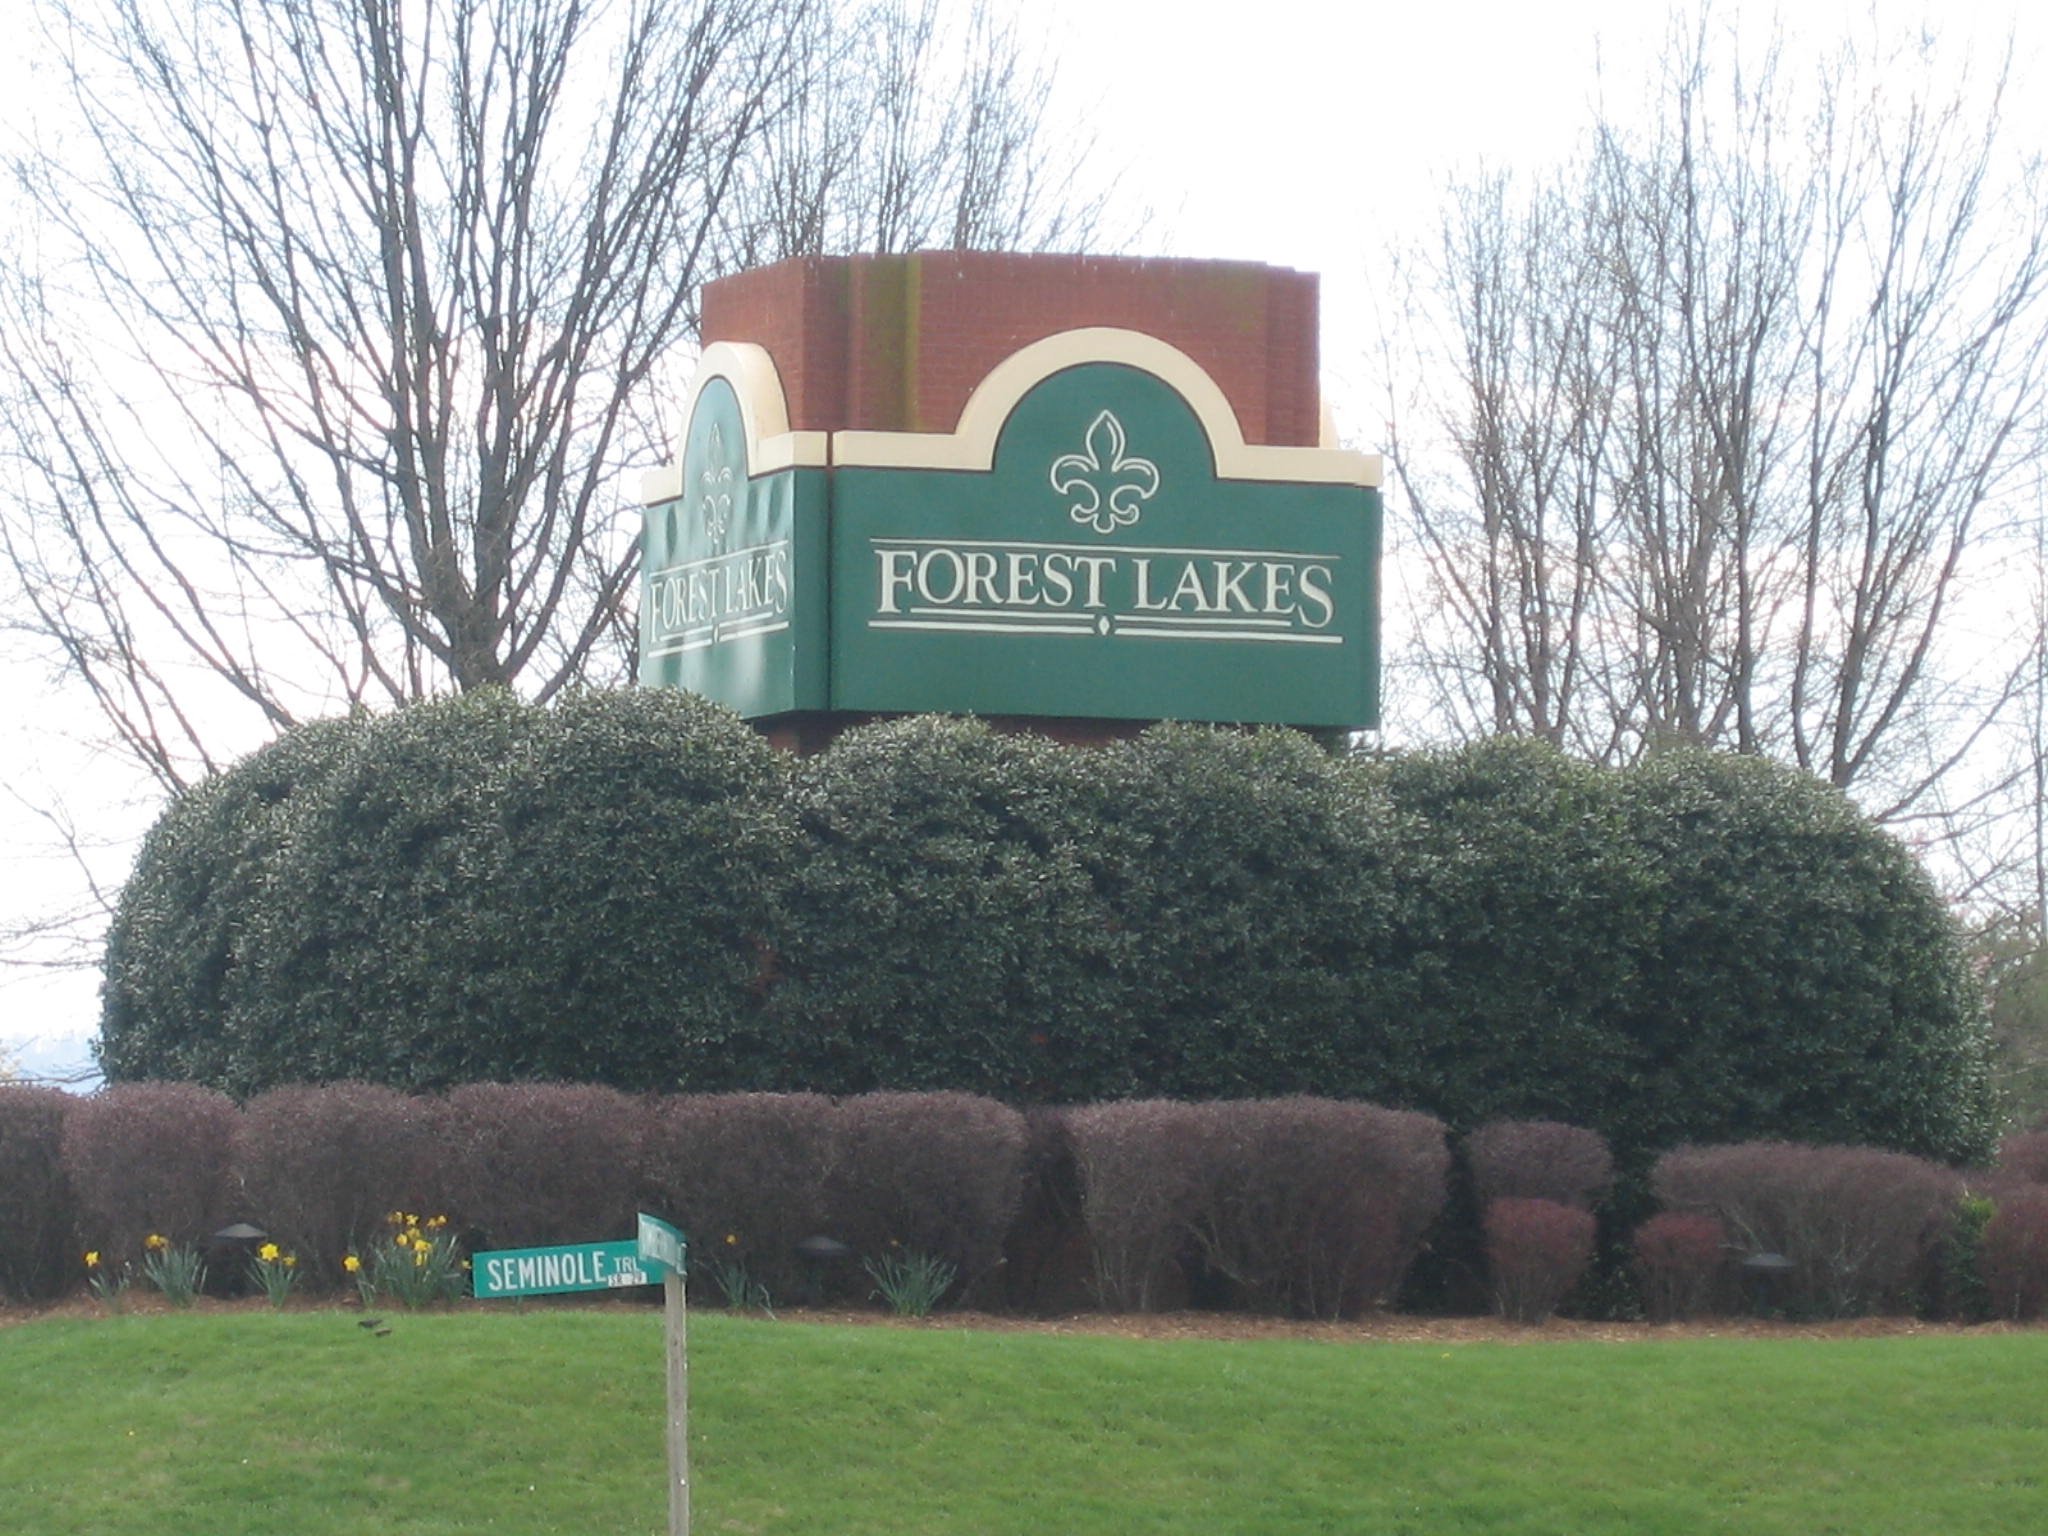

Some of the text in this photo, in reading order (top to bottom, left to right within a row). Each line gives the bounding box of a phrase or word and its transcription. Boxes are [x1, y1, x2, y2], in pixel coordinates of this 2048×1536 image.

[650, 551, 788, 643] FOREST LAKES
[874, 548, 1334, 628] FOREST LAKES
[487, 1251, 641, 1291] SEMINOLE TRL
